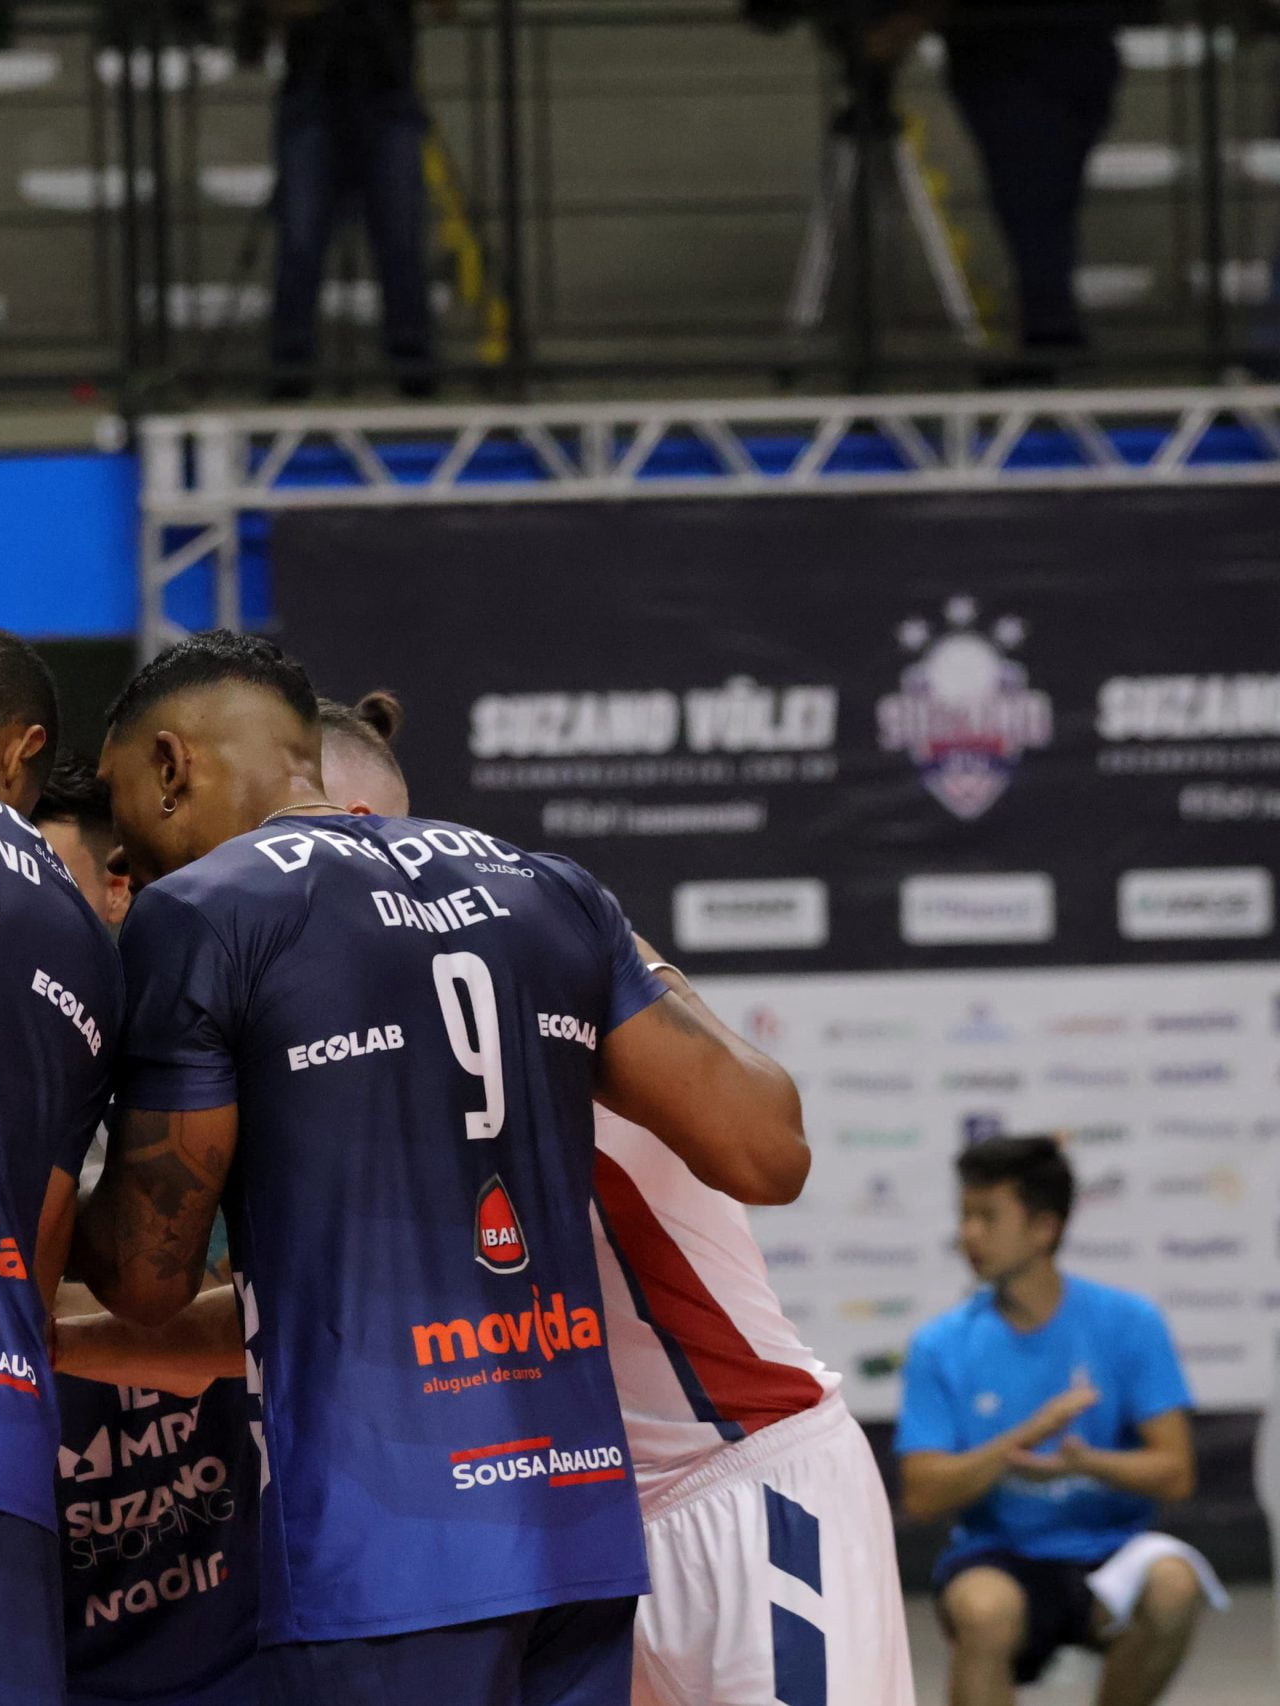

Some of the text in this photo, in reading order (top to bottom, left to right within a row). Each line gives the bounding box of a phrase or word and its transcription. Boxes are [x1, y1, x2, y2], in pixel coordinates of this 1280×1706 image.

[1097, 674, 1280, 740] SUZAN
[371, 886, 511, 933] DANIEL
[31, 969, 102, 1057] ECOLAB
[432, 952, 505, 1140] 9
[288, 1025, 405, 1071] ECOLAB
[412, 1283, 602, 1366] movida
[423, 1370, 488, 1394] aluguel
[491, 1367, 510, 1383] de
[121, 1397, 202, 1467] MR
[452, 1446, 623, 1489] SOUSA ARAUJO
